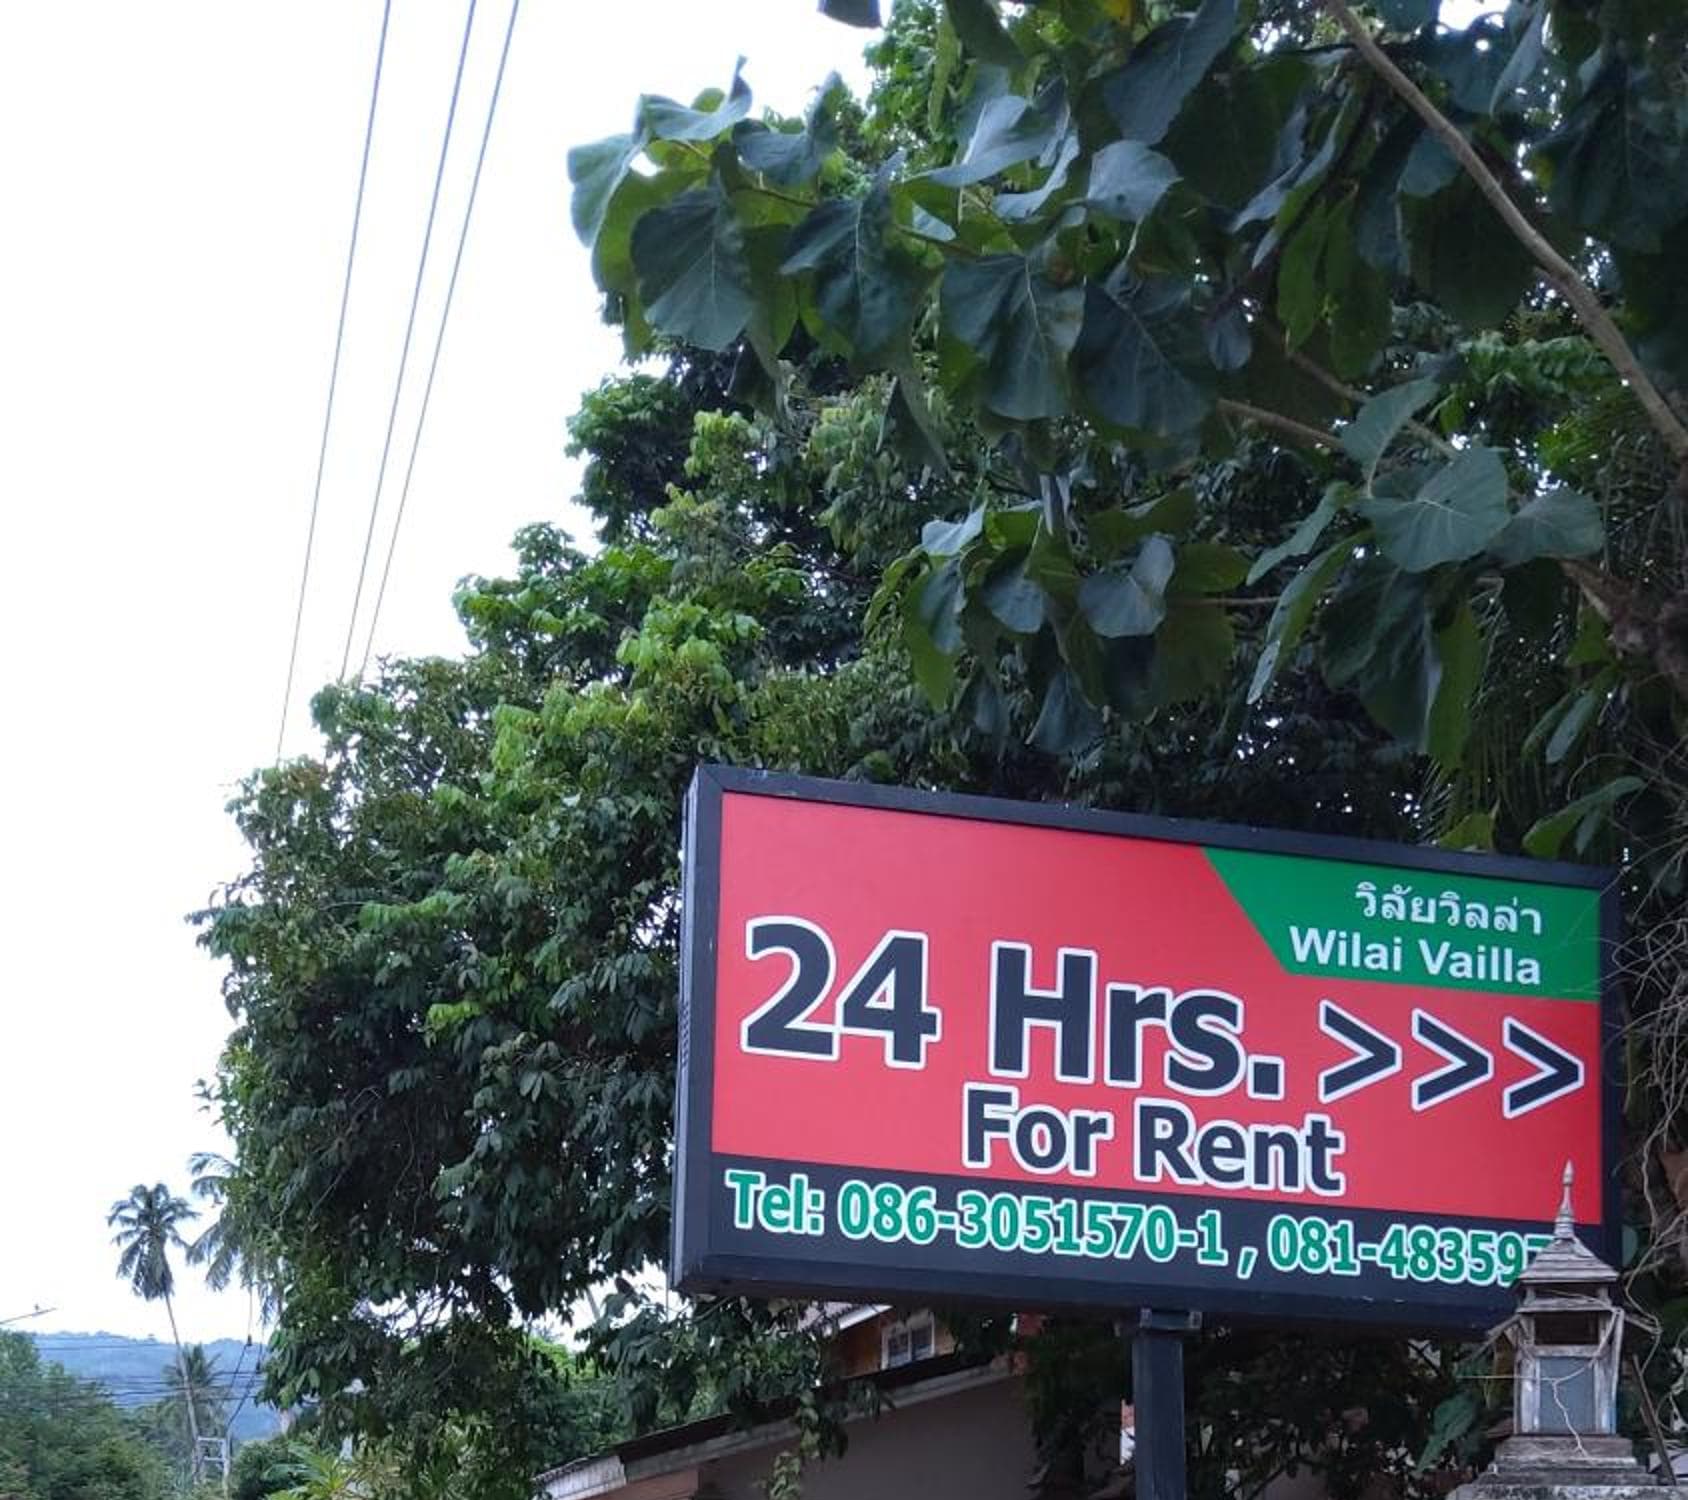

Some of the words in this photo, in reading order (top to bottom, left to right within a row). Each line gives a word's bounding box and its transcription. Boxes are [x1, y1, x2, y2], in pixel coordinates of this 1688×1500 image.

[1288, 925, 1403, 972] Wilai
[1418, 938, 1541, 985] Vailla
[740, 915, 942, 1070] 24
[988, 940, 1286, 1100] Hrs.
[961, 1081, 1114, 1177] For
[1133, 1096, 1347, 1197] Rent
[725, 1170, 826, 1235] Tel:
